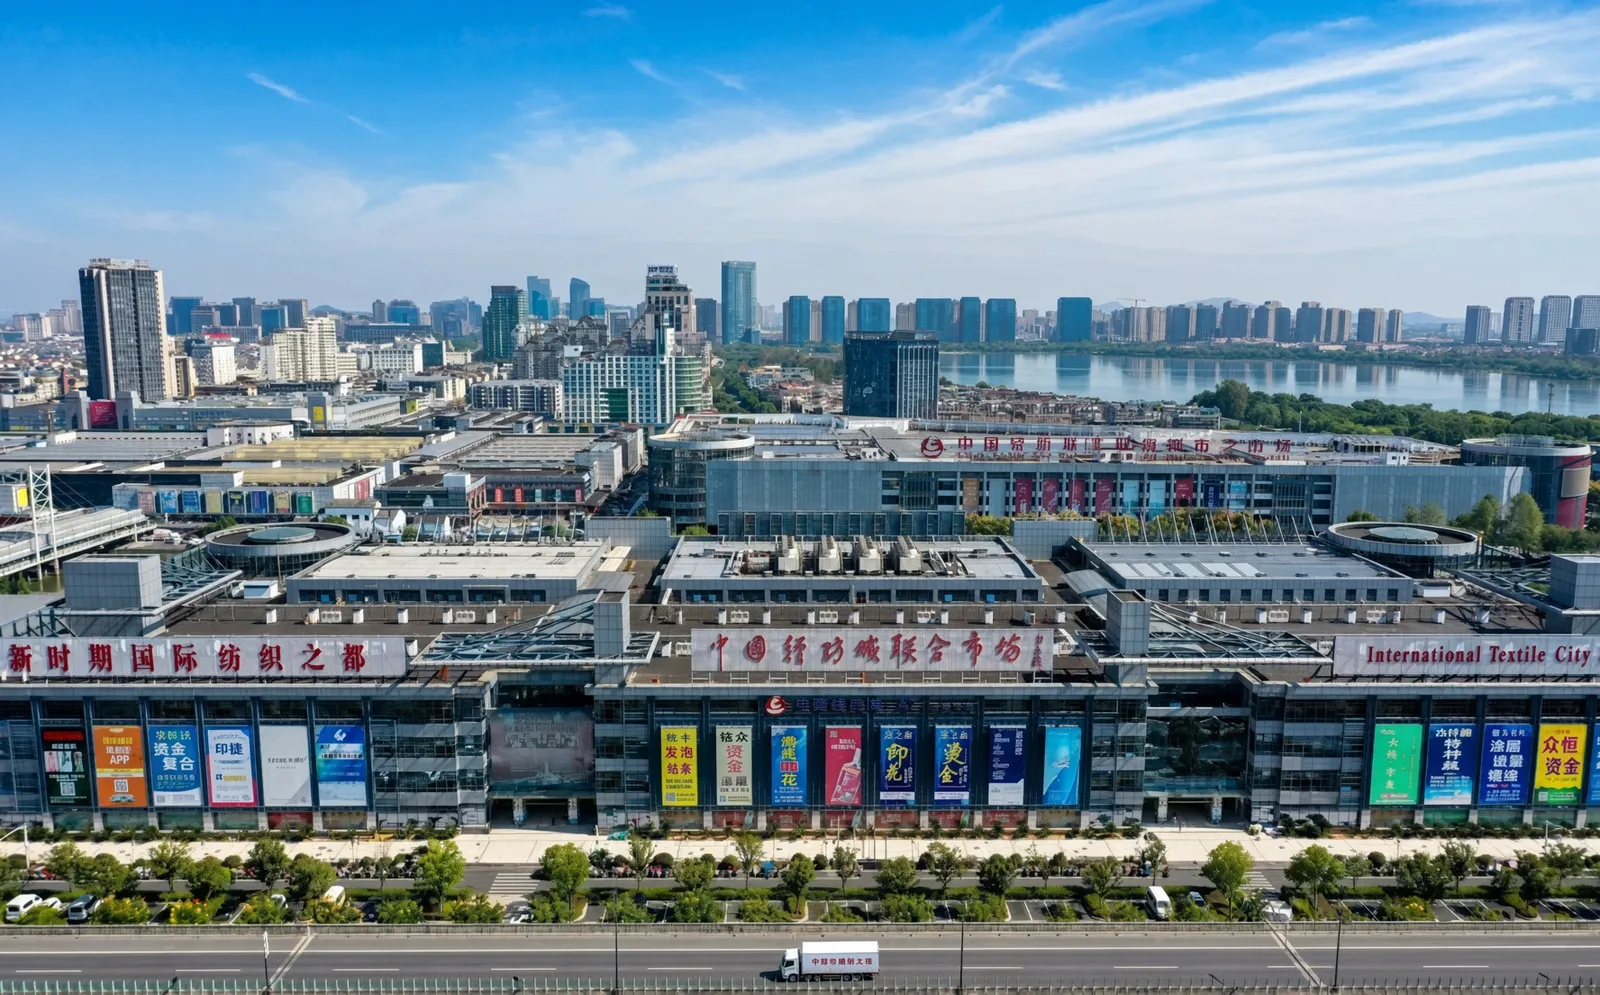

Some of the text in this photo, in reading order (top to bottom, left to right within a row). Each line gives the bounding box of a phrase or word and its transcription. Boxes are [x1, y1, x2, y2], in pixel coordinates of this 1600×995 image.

[9, 642, 366, 673] 新时期国际纺织之都
[1367, 645, 1592, 668] International Textile City
[1541, 735, 1579, 754] 众恒
[109, 754, 130, 765] APP
[1545, 756, 1581, 776] 资金
